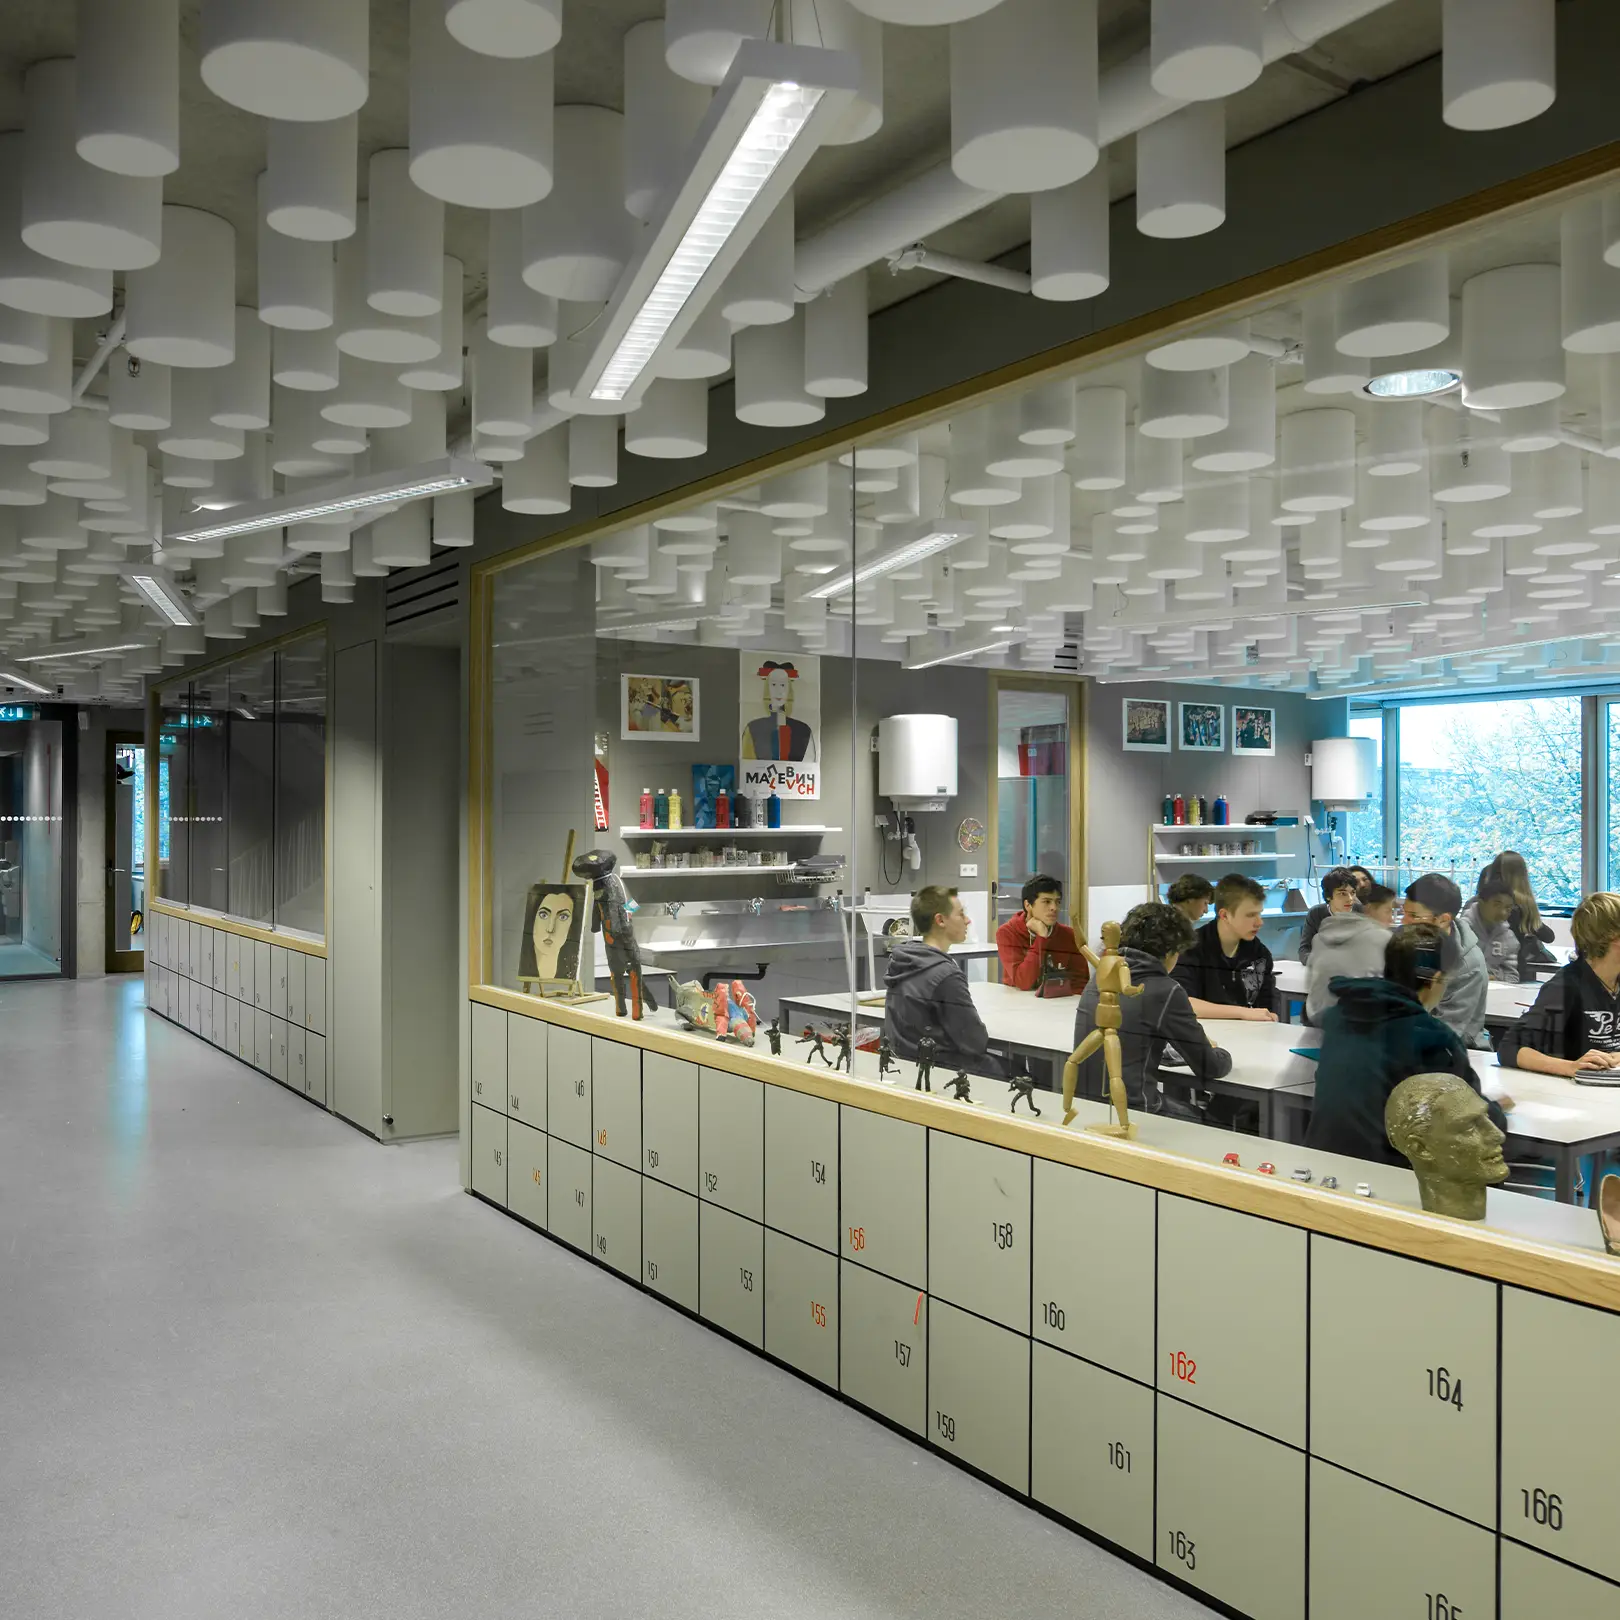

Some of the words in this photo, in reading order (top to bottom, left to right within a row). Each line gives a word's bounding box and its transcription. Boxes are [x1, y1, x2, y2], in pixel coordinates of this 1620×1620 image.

[575, 1080, 584, 1098] 146
[597, 1129, 607, 1146] 148
[648, 1149, 658, 1168] 150
[705, 1172, 717, 1192] 152
[811, 1161, 825, 1184] 154
[575, 1189, 584, 1207] 147
[597, 1234, 606, 1254] 149
[849, 1227, 864, 1251] 156
[993, 1223, 1012, 1250] 158
[648, 1261, 657, 1280] 151
[740, 1268, 752, 1292] 153
[811, 1301, 826, 1328] 155
[1043, 1302, 1065, 1331] 160
[895, 1340, 911, 1367] 157
[1170, 1351, 1196, 1384] 162
[1427, 1367, 1463, 1412] 164
[937, 1411, 955, 1442] 159
[1108, 1442, 1130, 1473] 161
[1521, 1488, 1562, 1531] 166
[1169, 1531, 1195, 1570] 163
